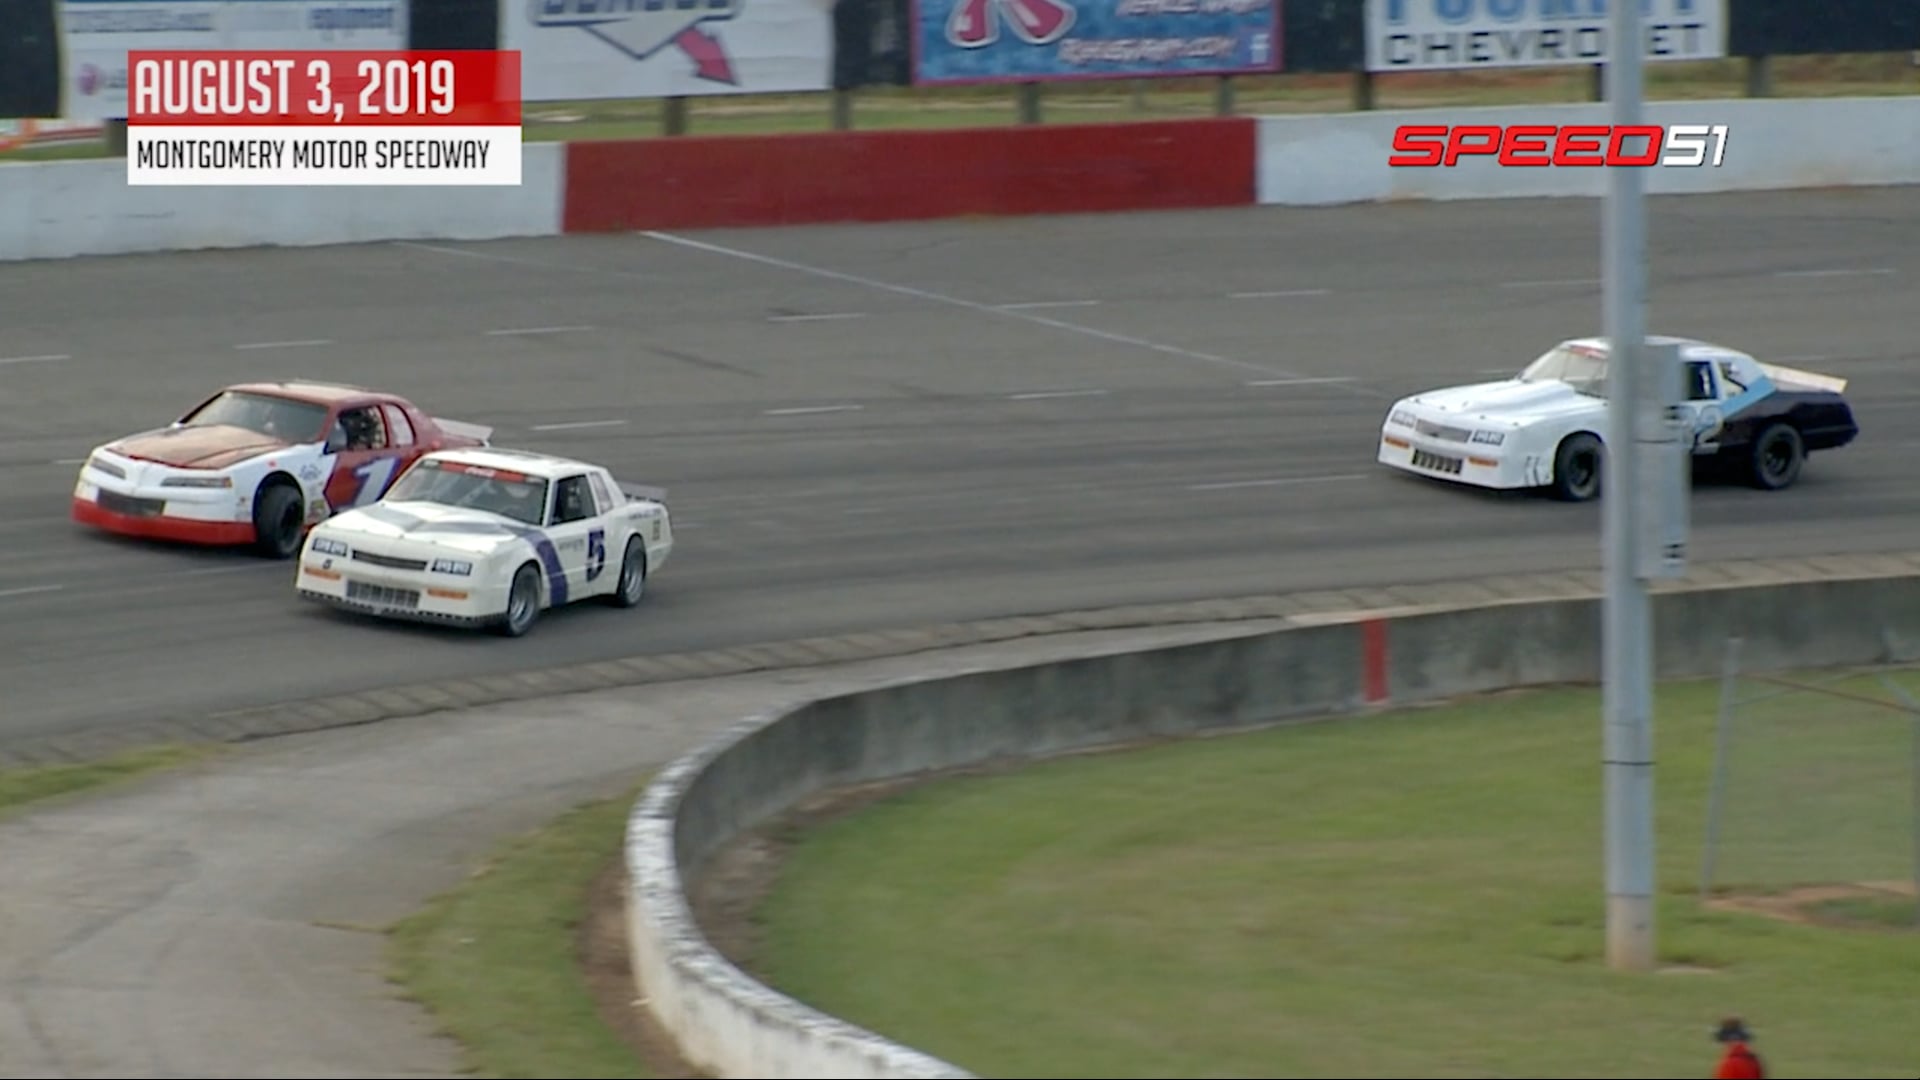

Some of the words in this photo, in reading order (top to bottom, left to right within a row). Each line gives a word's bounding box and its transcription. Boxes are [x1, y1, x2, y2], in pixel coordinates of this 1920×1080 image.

[1385, 24, 1705, 66] CHEVROET
[345, 456, 399, 509] 1
[585, 530, 606, 583] 5
